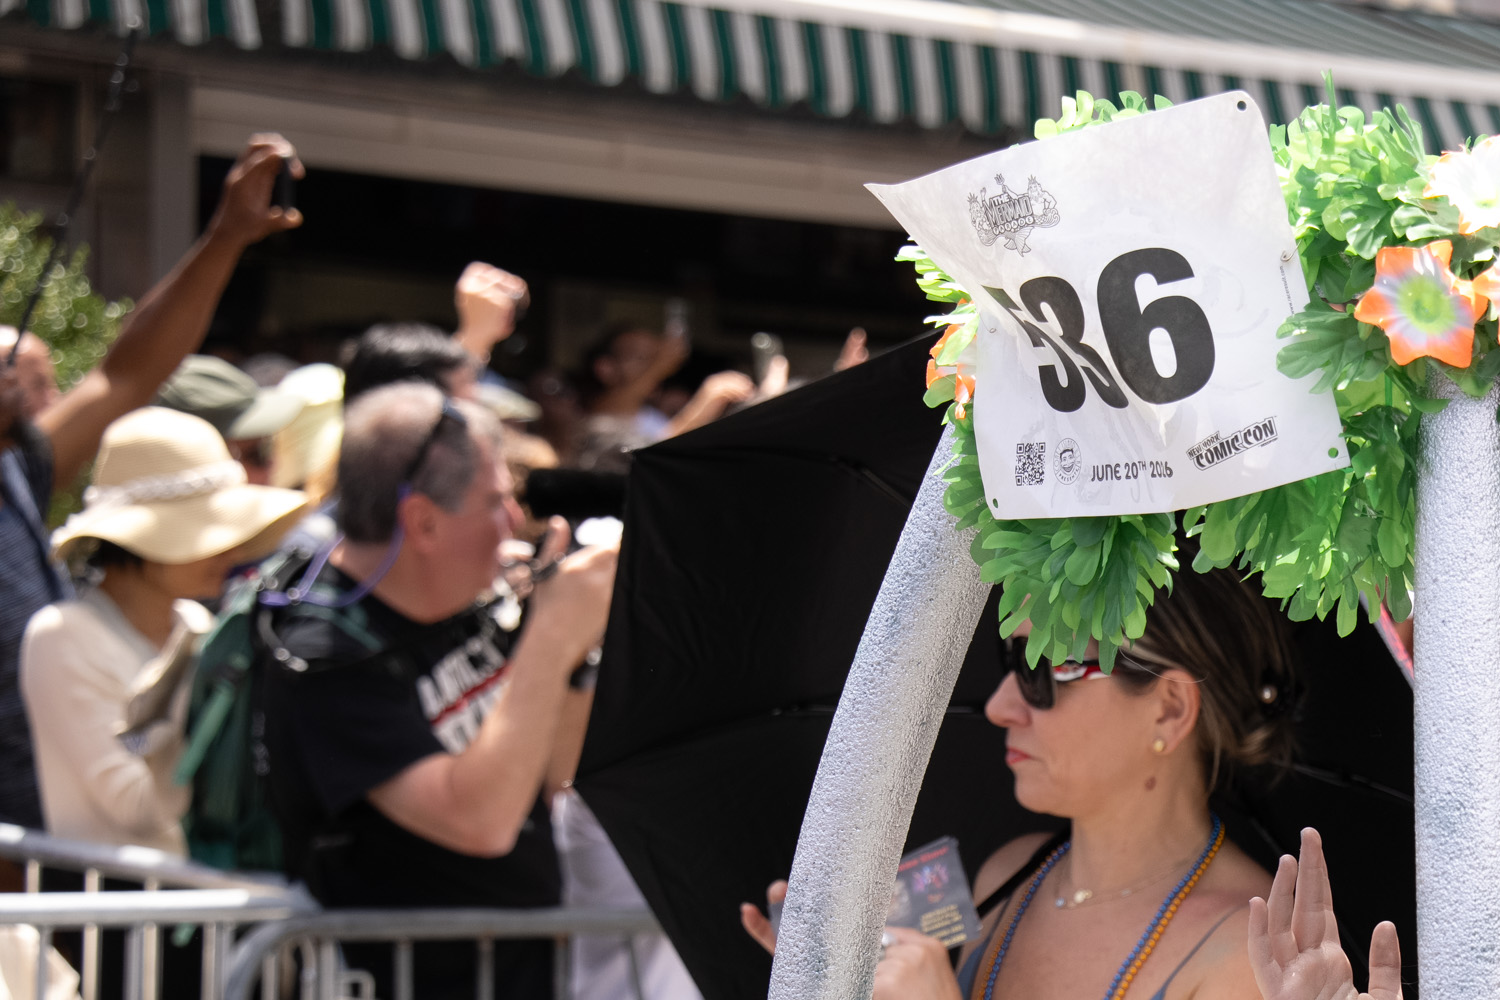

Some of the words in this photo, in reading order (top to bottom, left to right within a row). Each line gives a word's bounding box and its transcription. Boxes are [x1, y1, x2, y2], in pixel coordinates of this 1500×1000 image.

[982, 196, 1033, 228] MERMAID
[1188, 445, 1203, 458] NEW
[1203, 433, 1221, 449] YORK
[1196, 434, 1241, 468] COMIC
[1243, 419, 1275, 446] CON
[1091, 463, 1122, 482] JUNE
